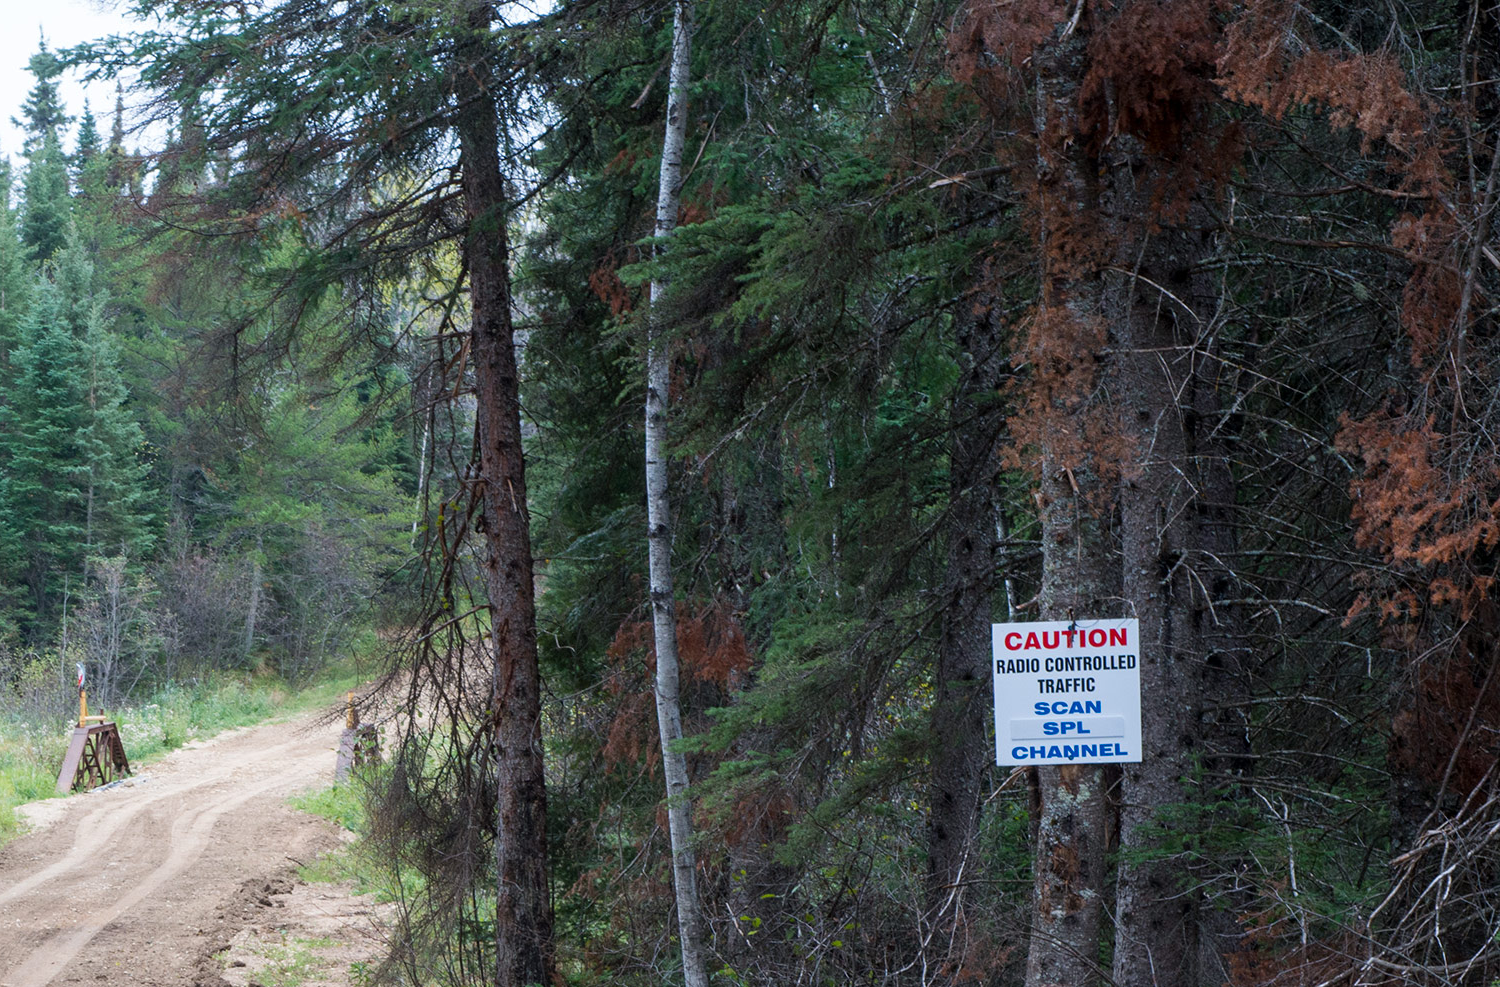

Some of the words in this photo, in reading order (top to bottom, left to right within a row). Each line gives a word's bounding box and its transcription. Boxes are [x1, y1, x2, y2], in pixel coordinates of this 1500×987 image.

[1004, 628, 1127, 651] CAUTION
[996, 658, 1040, 674] RADIO
[1045, 654, 1136, 672] CONTROLLED
[1037, 677, 1096, 694] TRAFFIC
[1034, 700, 1102, 716] SCAN
[1043, 721, 1091, 735] SPL
[1011, 743, 1128, 760] CHANNEL
